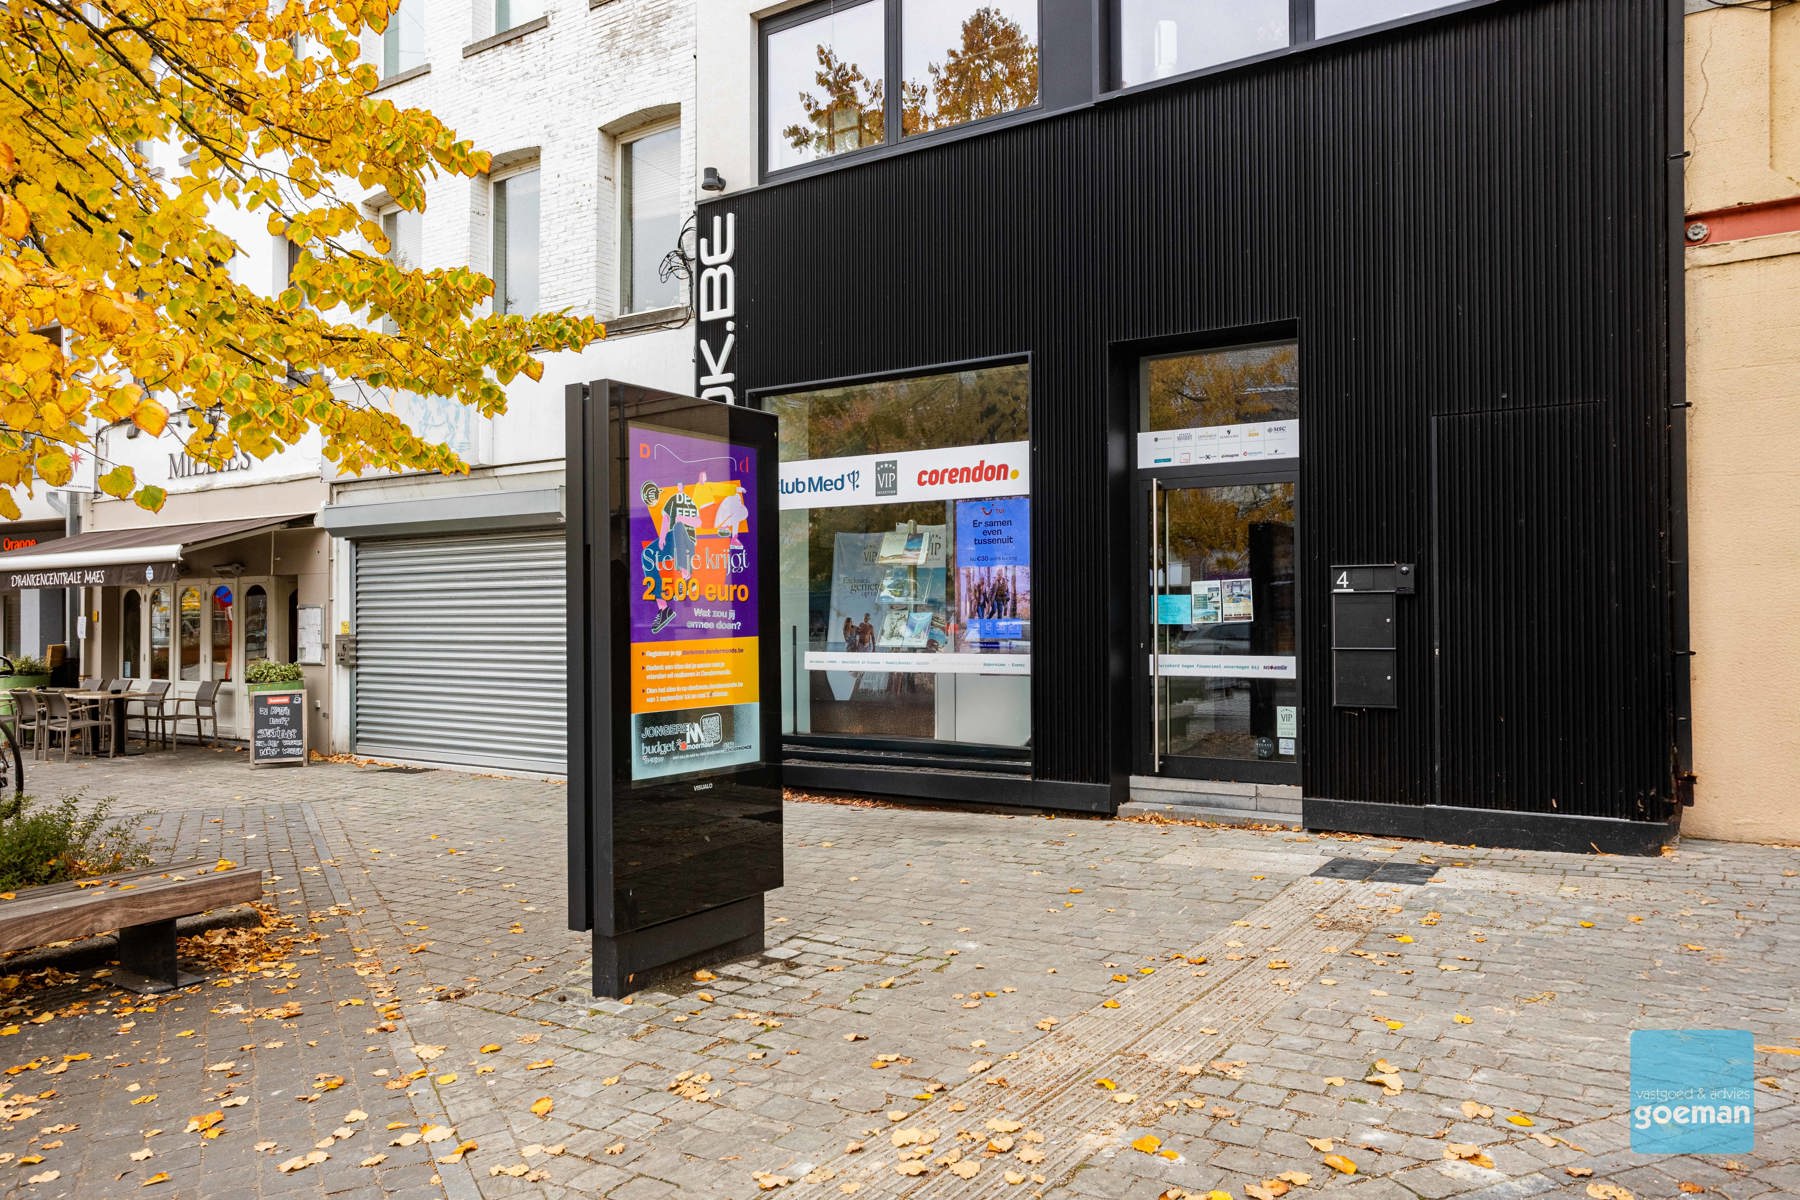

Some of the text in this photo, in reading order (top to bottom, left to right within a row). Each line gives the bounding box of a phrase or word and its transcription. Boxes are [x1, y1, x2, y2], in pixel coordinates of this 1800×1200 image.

[778, 474, 845, 495] lub Med
[877, 472, 896, 488] VIP
[972, 519, 1012, 528] Er samen
[974, 535, 1014, 545] tussenuit
[930, 543, 941, 555] IP
[642, 546, 750, 577] Stel je krijgt
[11, 569, 105, 588] DRANKENCENTRALE MAES
[1336, 570, 1349, 588] 4
[642, 576, 750, 602] 2 500 euro
[693, 607, 711, 618] Wat
[1280, 713, 1293, 722] VIP
[641, 740, 676, 755] budget
